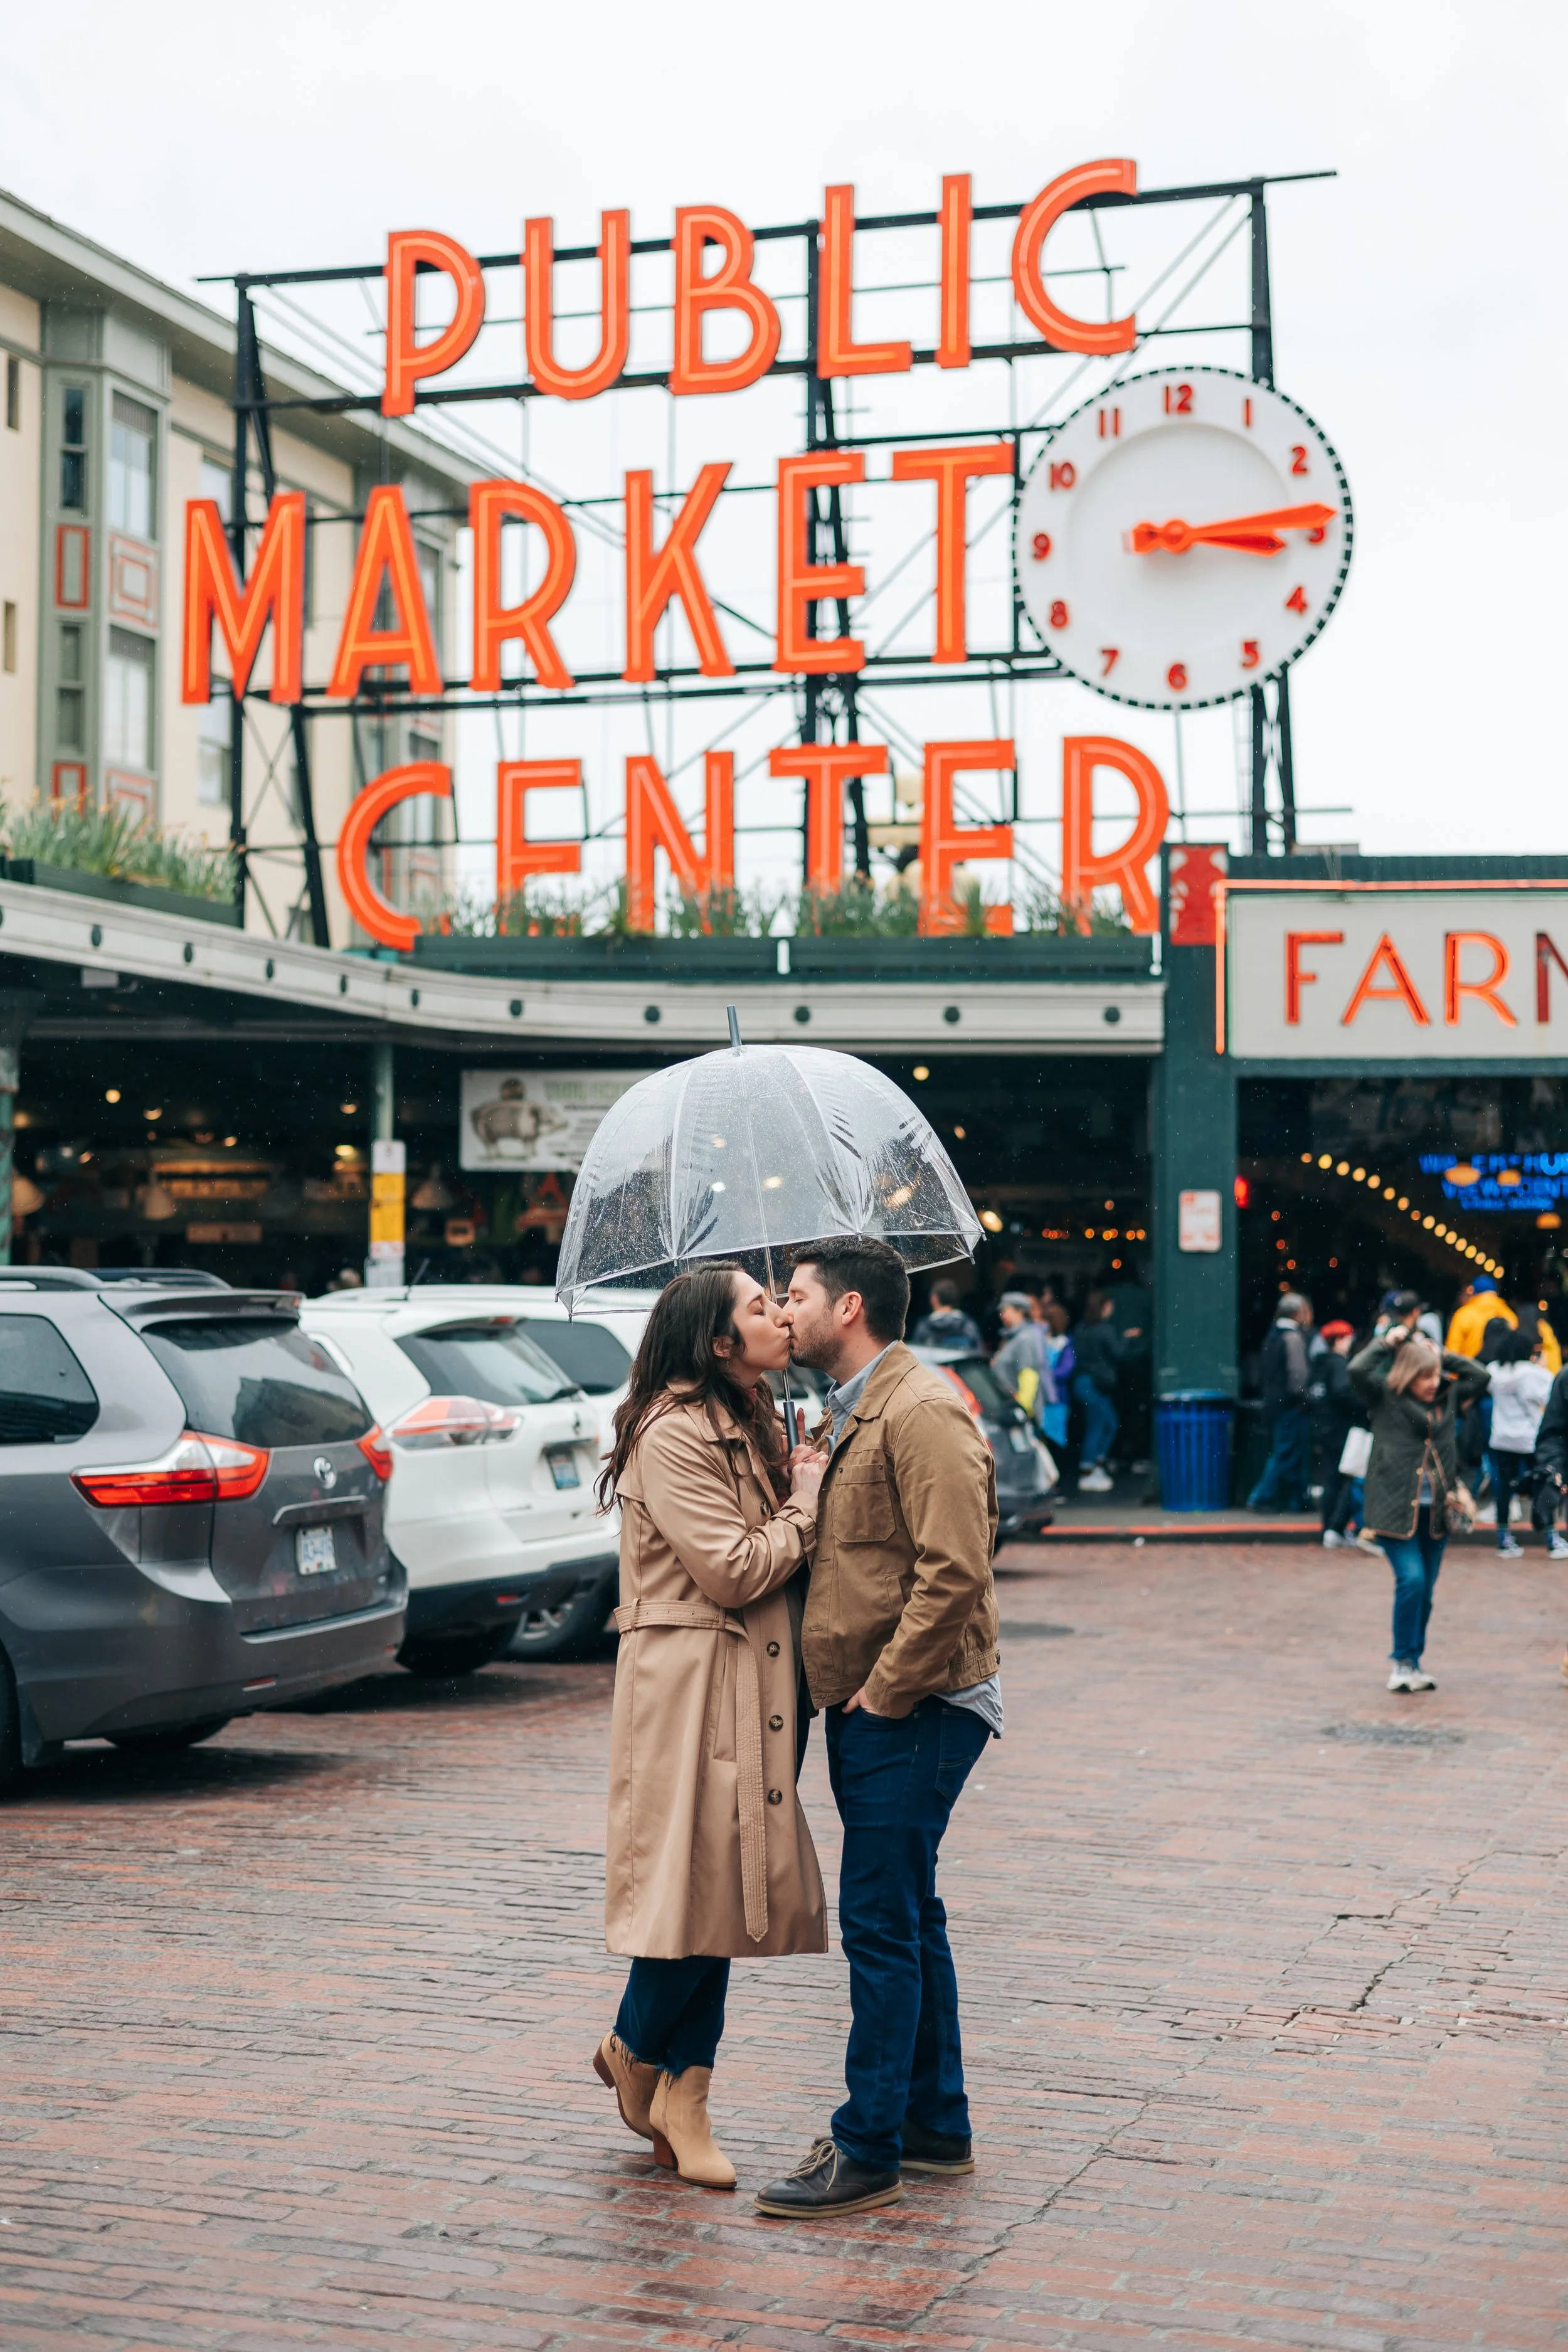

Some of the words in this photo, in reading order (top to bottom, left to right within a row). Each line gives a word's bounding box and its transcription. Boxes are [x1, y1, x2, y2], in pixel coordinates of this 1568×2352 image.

[381, 157, 1137, 417] PUBLIC
[1164, 383, 1194, 415] 12
[1243, 398, 1252, 428] 1
[1098, 408, 1121, 438] 11
[1291, 445, 1308, 475] 2
[1048, 461, 1076, 490] 10
[1032, 532, 1052, 561] 9
[180, 441, 1016, 706] MARKET
[1285, 585, 1308, 614] 4
[1049, 600, 1069, 630] 8
[1101, 649, 1120, 676] 7
[1241, 640, 1261, 669] 5
[1166, 662, 1188, 691] 6
[335, 735, 1172, 951] CENTER
